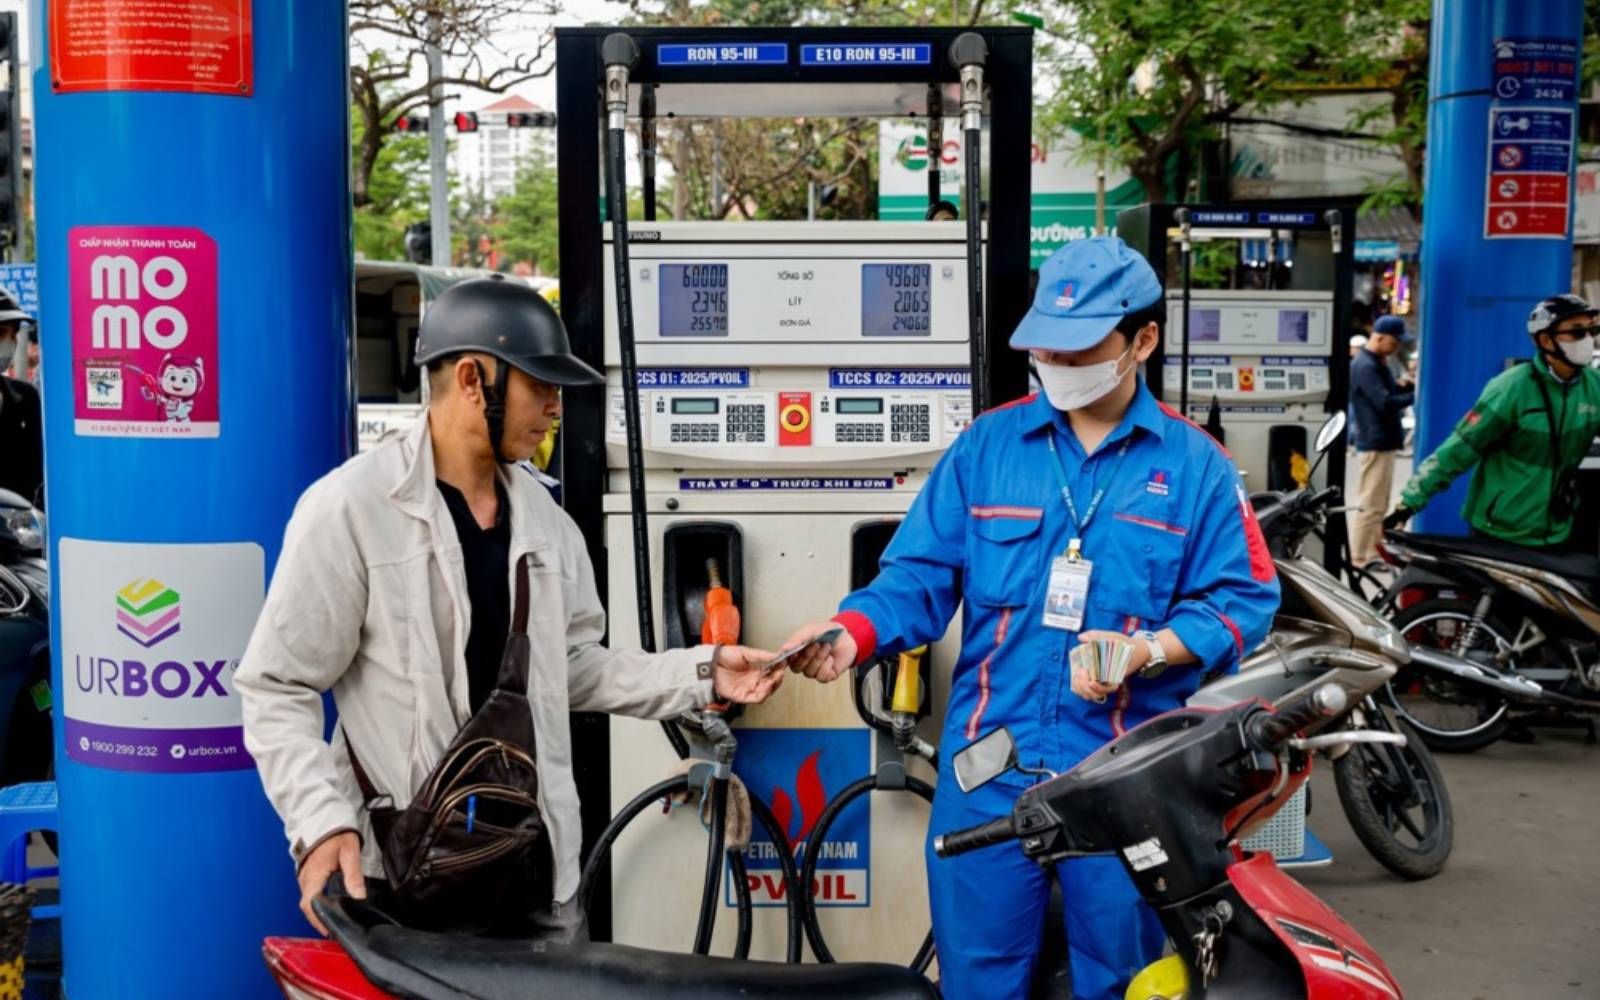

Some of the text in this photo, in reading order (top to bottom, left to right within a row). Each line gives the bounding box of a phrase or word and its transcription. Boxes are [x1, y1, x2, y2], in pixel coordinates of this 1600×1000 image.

[688, 47, 757, 60] RON 95-III
[816, 47, 915, 61] E10 RON 95-III
[131, 239, 165, 248] THANH
[168, 238, 196, 249] TOÁN
[683, 265, 727, 288] 60000
[886, 265, 930, 288] 49684
[788, 296, 802, 306] LÍT
[691, 316, 727, 331] 25570
[892, 316, 929, 331] 24060
[660, 372, 677, 384] 01:
[680, 372, 742, 385] 2025/PVOIL
[838, 372, 871, 385] TCCS
[875, 372, 896, 385] 02:
[824, 480, 849, 488] KHI
[76, 654, 229, 698] URBOX
[91, 741, 237, 756] 1900 299 232 urbox.vn
